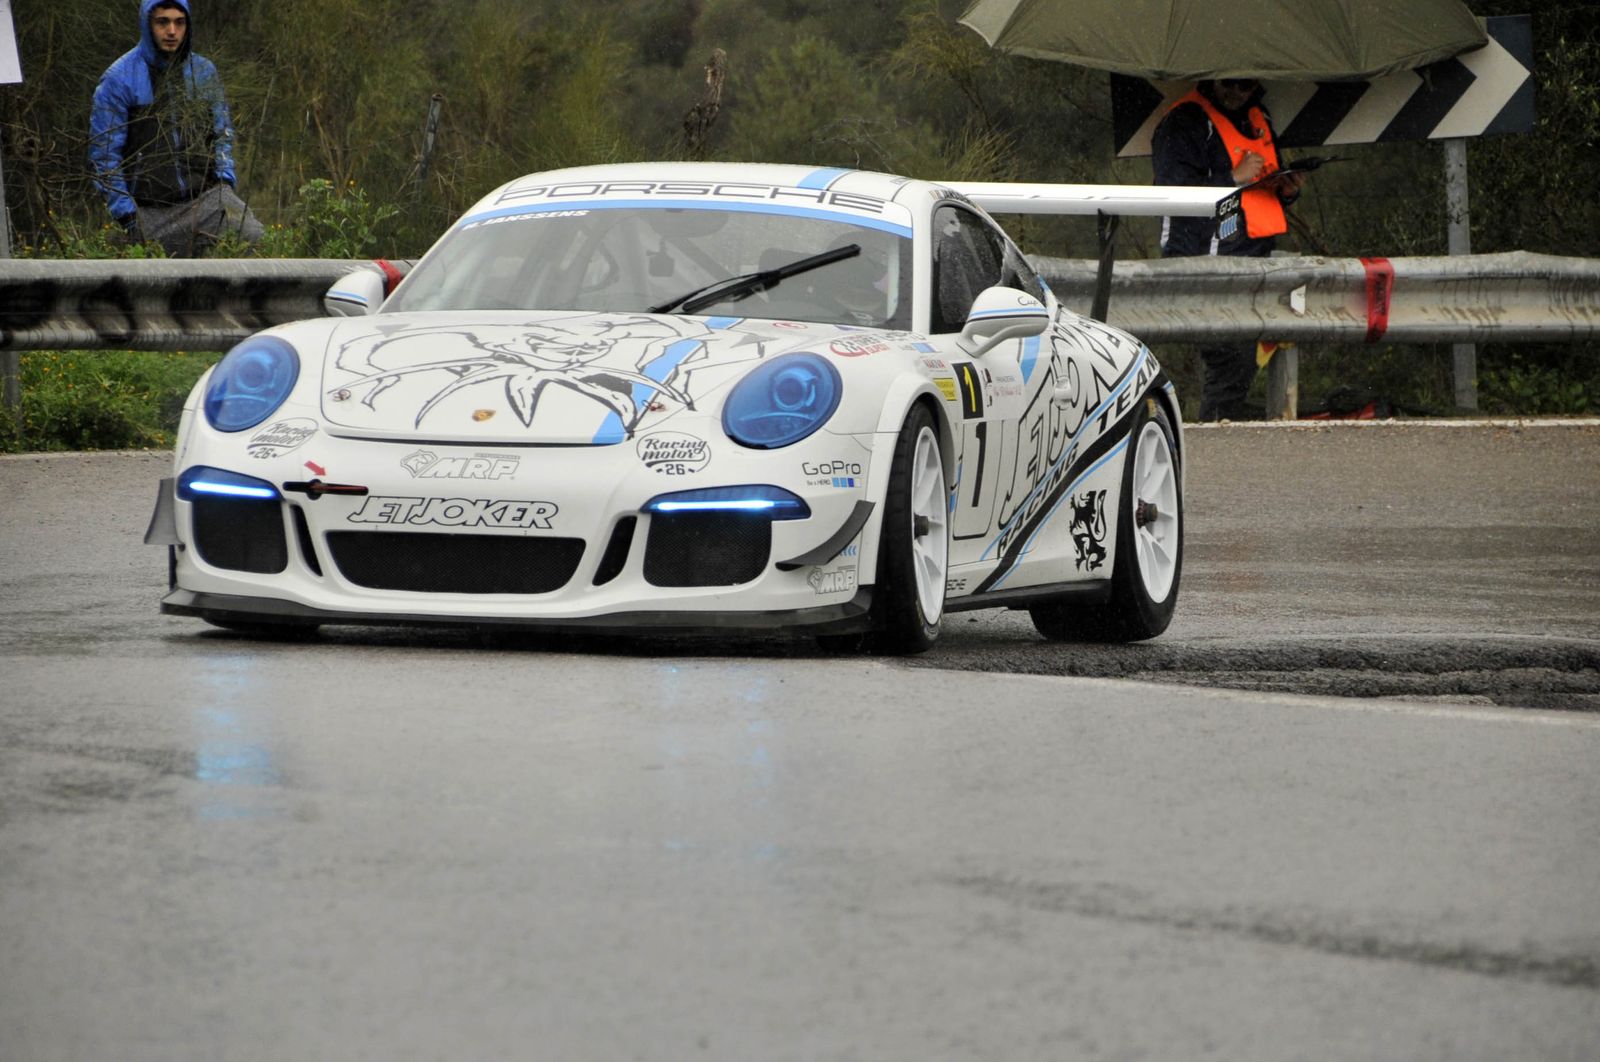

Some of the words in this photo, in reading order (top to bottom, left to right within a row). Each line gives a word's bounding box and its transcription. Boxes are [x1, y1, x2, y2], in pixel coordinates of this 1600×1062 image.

[495, 181, 887, 214] PORSCHE
[481, 209, 591, 225] JANSSENS
[1018, 296, 1038, 306] Cup
[962, 365, 977, 413] 1
[1097, 353, 1160, 435] TEAM
[644, 438, 708, 454] Racing
[418, 456, 520, 480] MRP
[665, 463, 686, 475] 26
[802, 460, 862, 476] GoPro
[971, 421, 987, 507] 1
[347, 496, 559, 529] JETJOKER
[997, 442, 1080, 560] RACING
[817, 570, 857, 595] MRP
